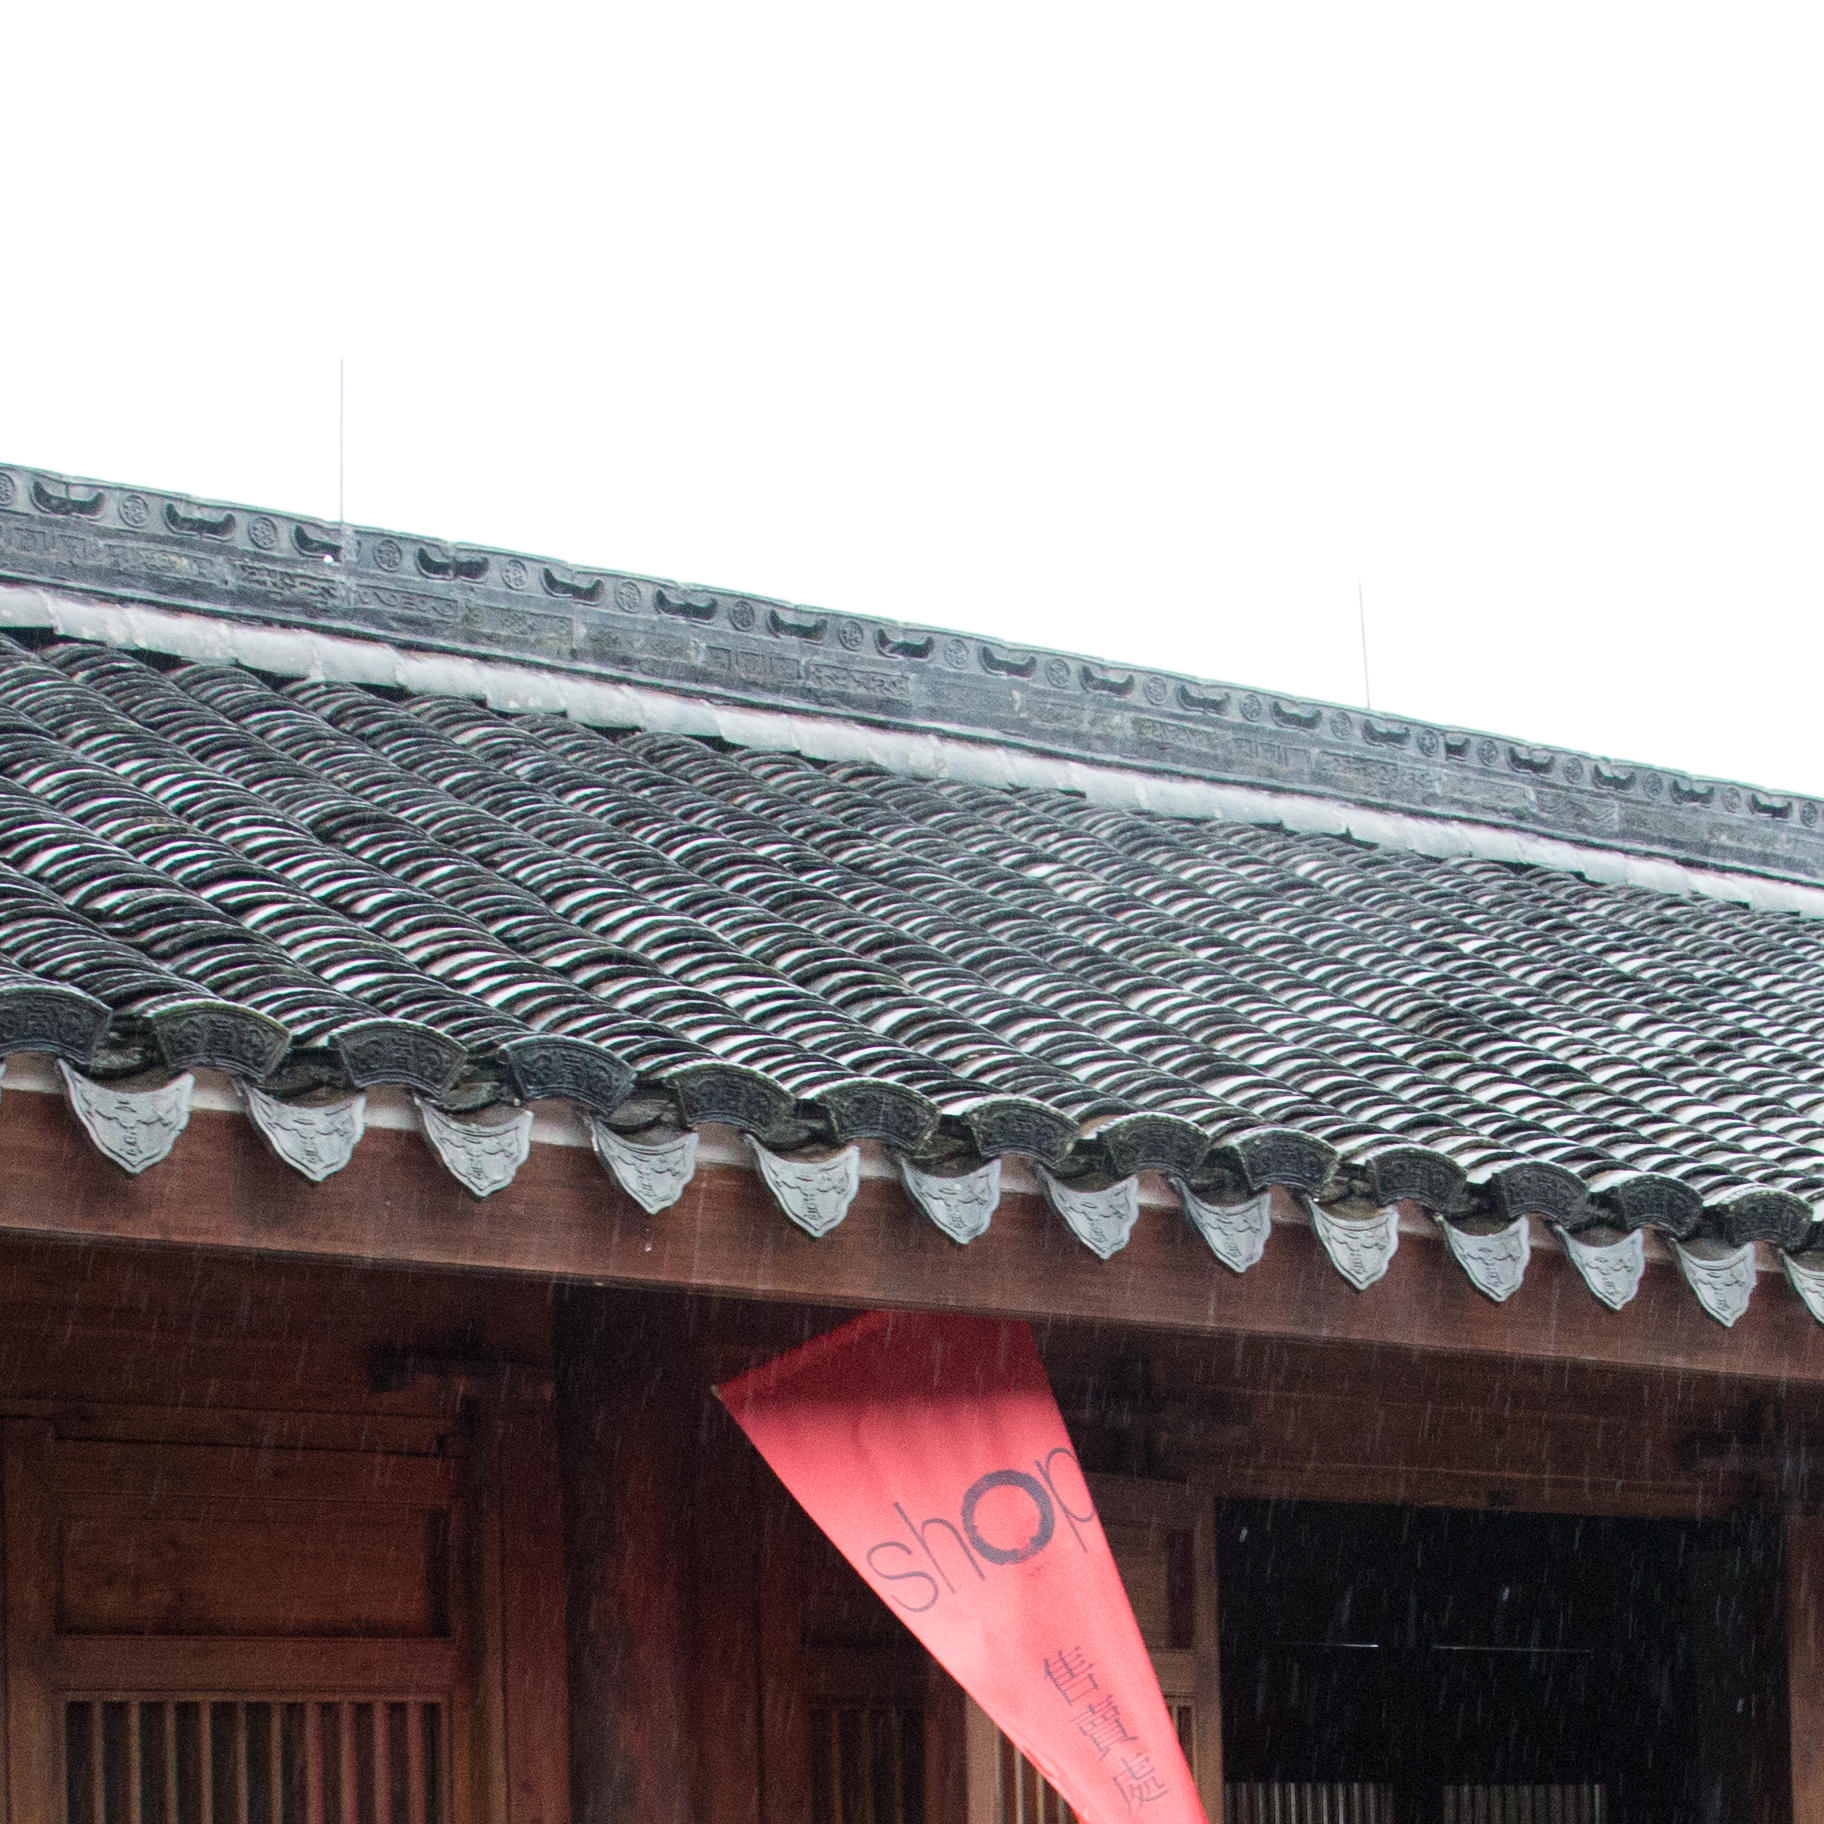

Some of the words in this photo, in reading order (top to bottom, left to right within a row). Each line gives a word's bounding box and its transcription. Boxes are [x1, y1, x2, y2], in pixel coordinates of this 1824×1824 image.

[865, 1447, 1094, 1613] shop
[1044, 1646, 1169, 1813] 售賣處
